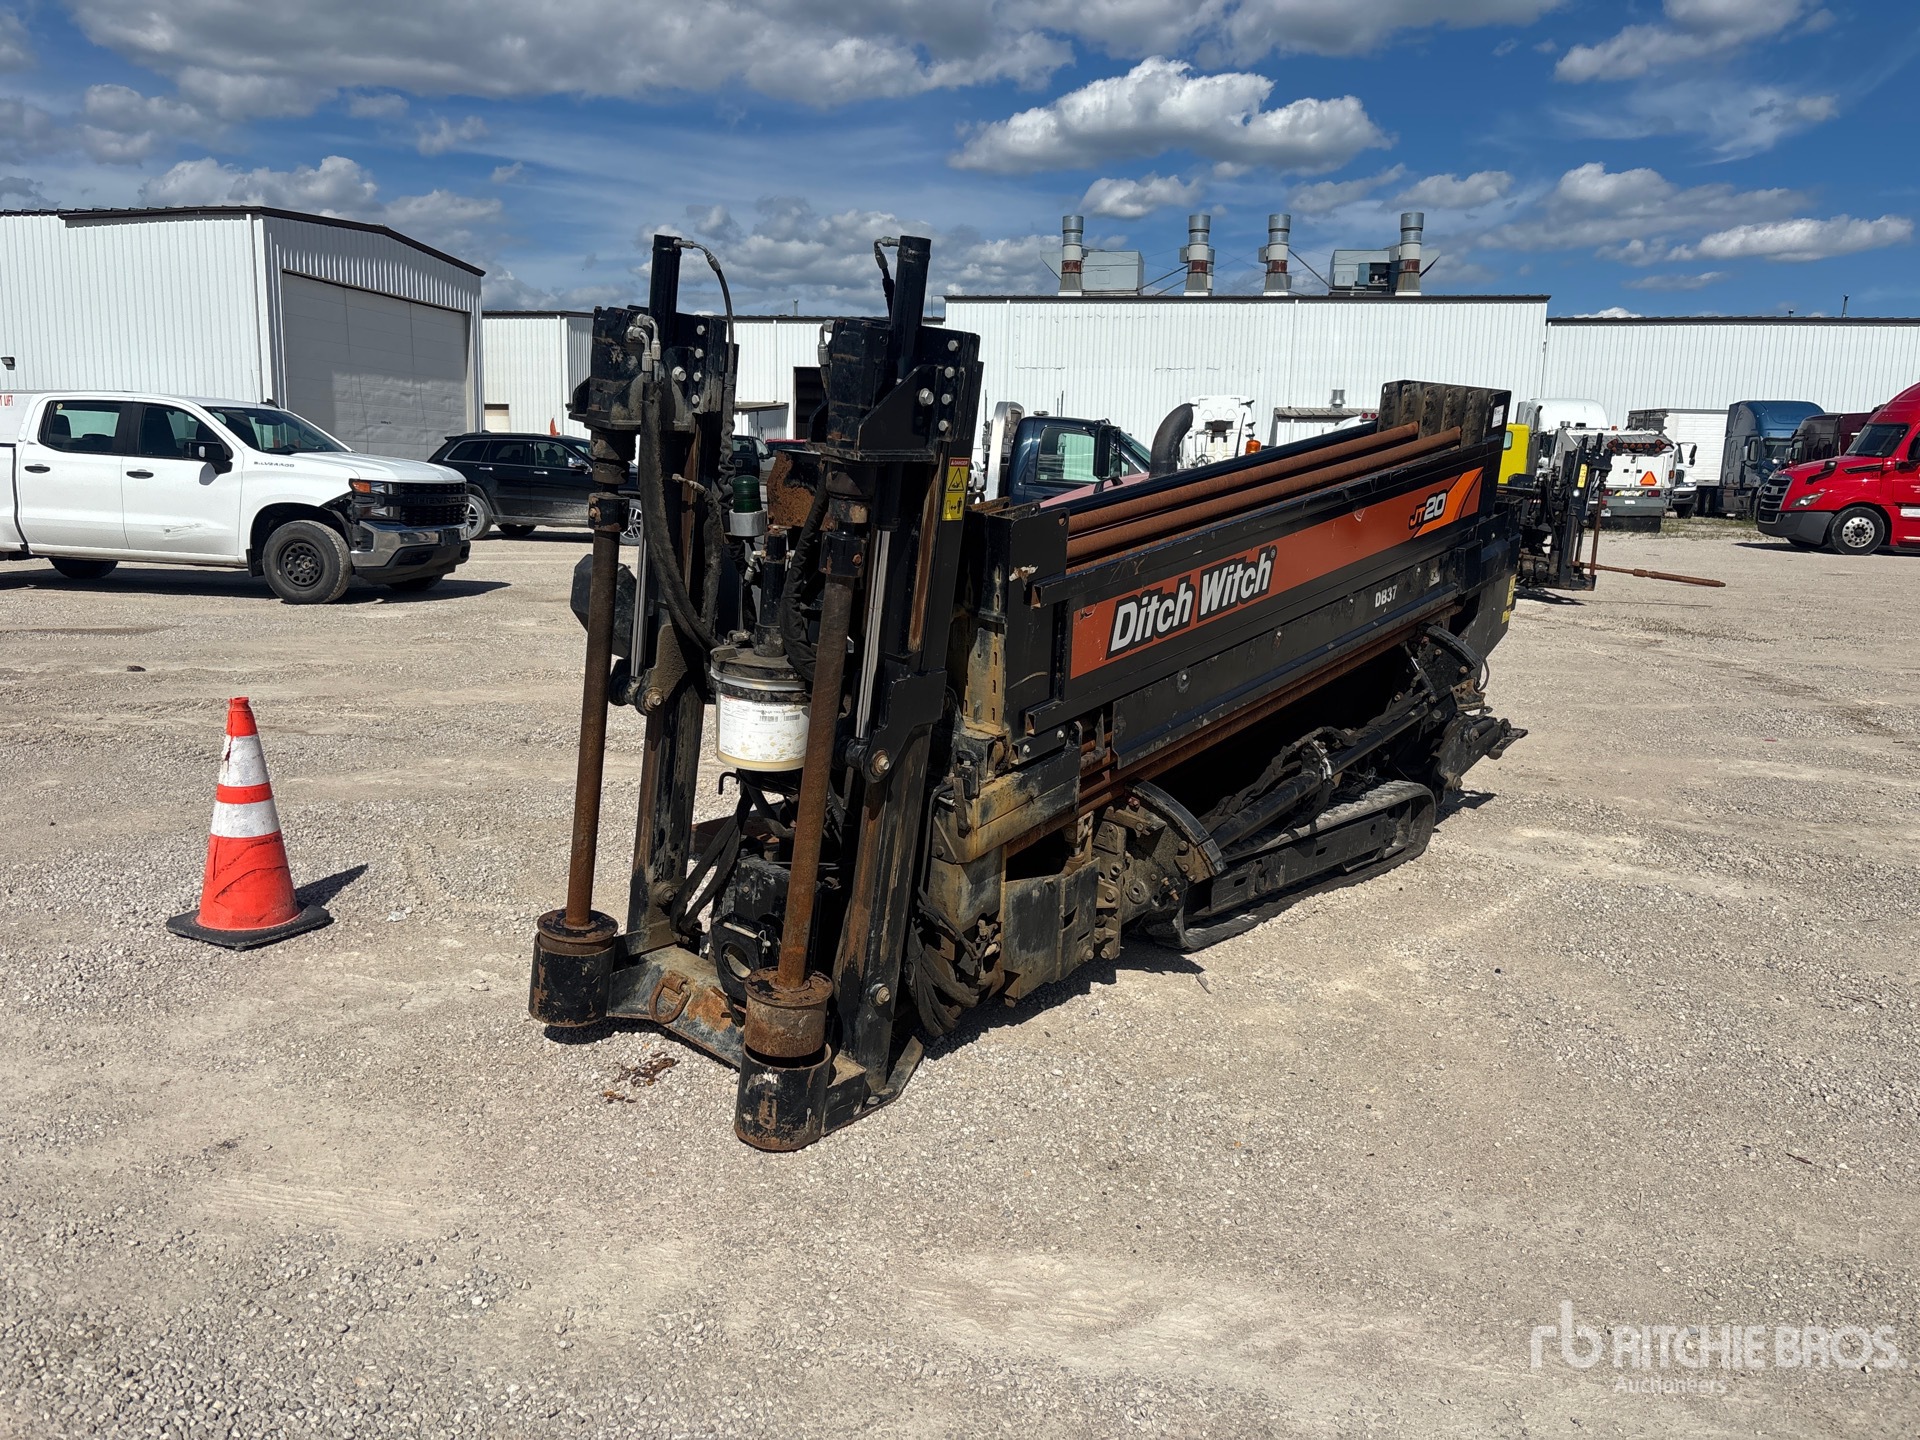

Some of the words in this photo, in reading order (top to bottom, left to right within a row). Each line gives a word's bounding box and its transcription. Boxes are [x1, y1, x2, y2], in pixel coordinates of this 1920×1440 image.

[1409, 492, 1447, 527] JT20
[1374, 584, 1398, 608] DB37
[1110, 582, 1194, 652] Ditch
